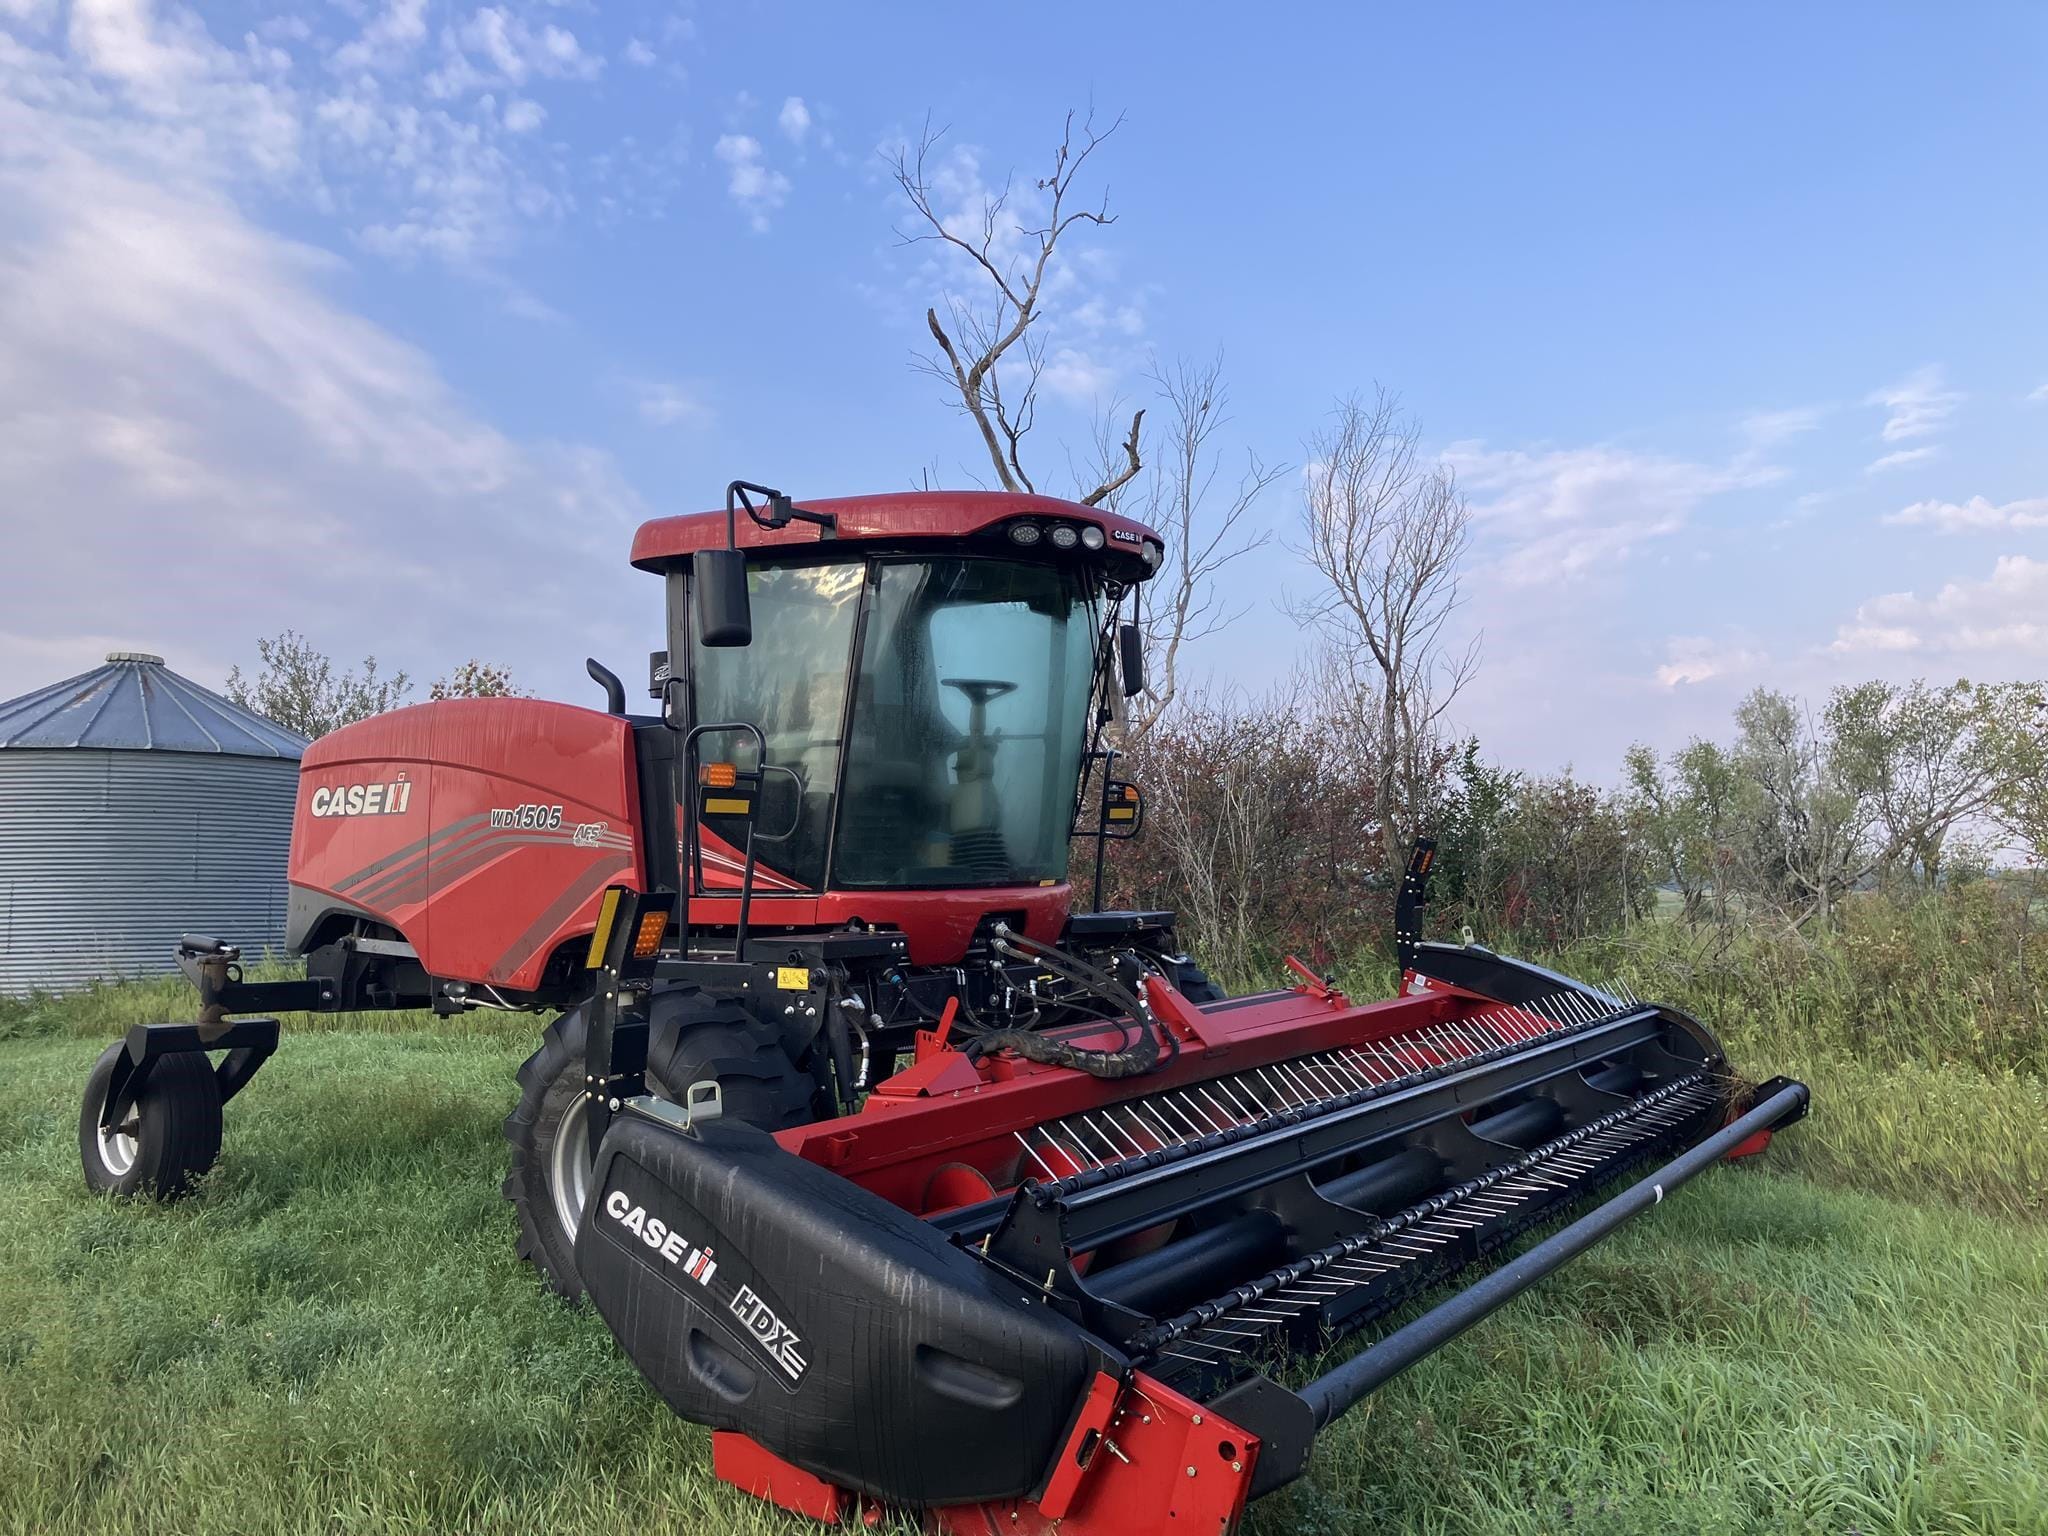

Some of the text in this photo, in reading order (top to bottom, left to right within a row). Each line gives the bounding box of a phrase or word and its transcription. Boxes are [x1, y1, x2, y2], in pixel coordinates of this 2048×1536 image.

[1115, 530, 1135, 541] CASE
[311, 784, 384, 817] CASE
[491, 804, 563, 830] WD1505
[575, 824, 600, 840] AFS
[606, 1190, 688, 1264] CASE
[729, 1284, 807, 1380] HDX
